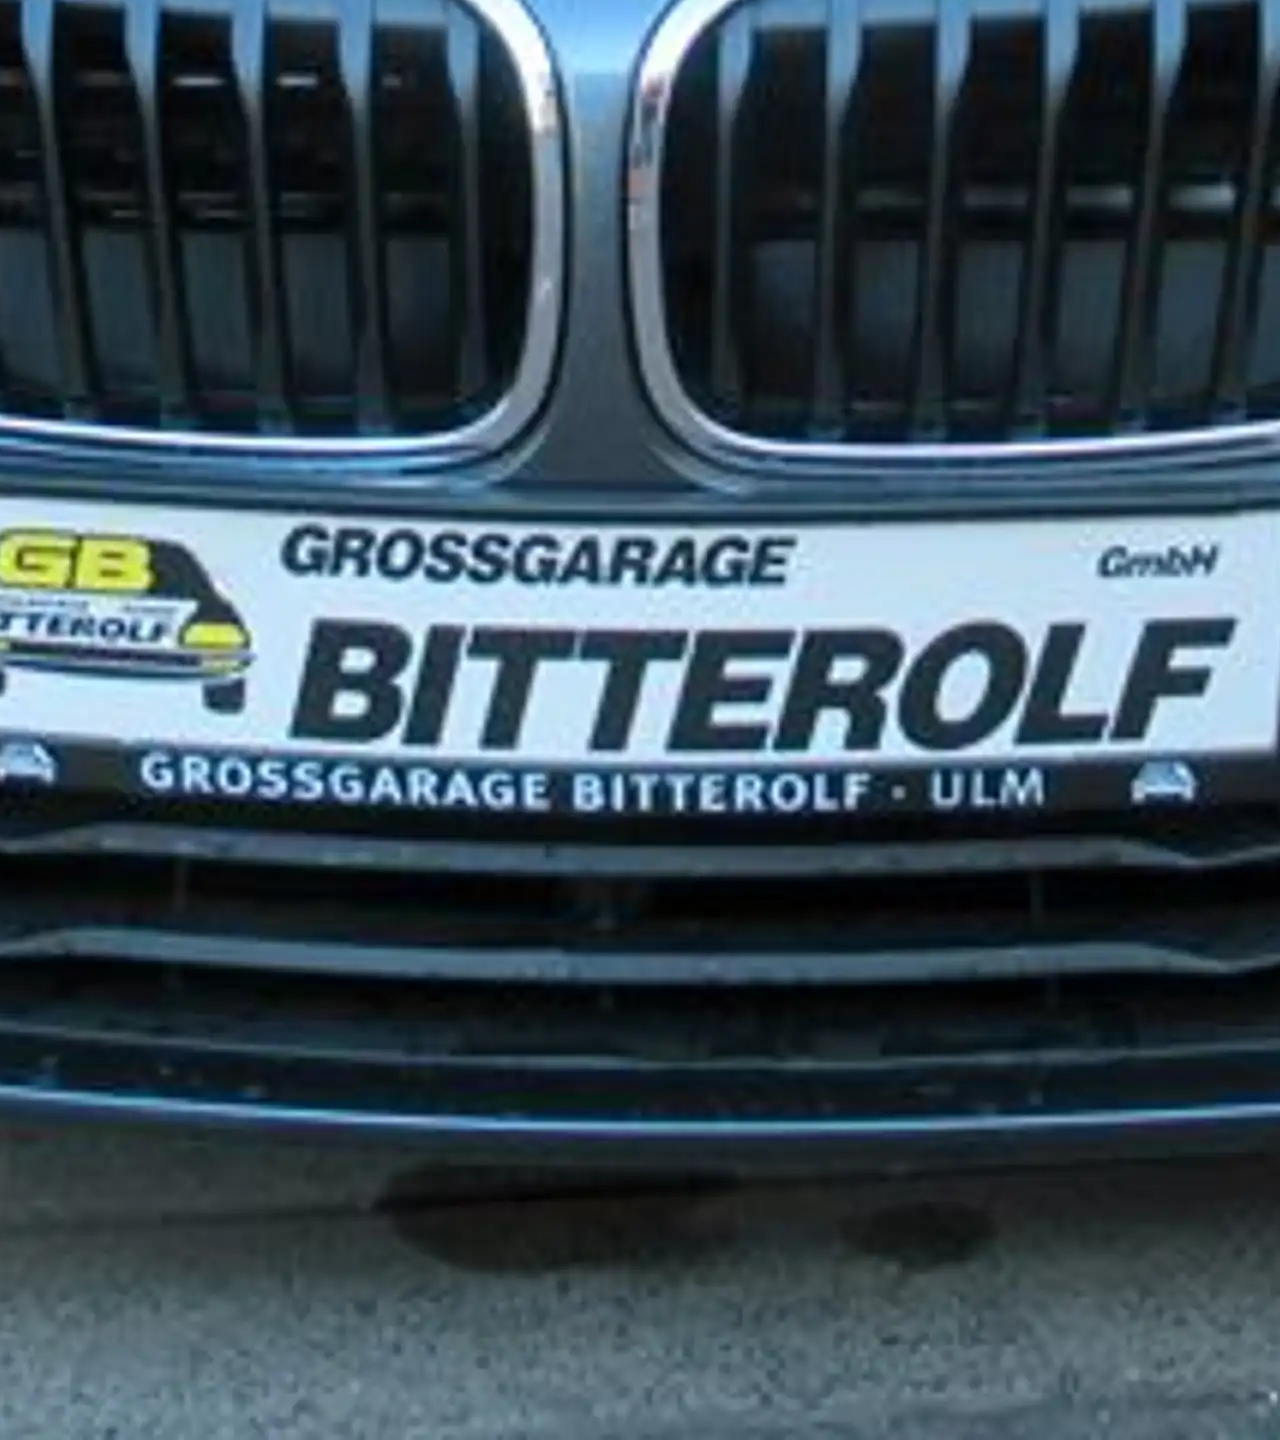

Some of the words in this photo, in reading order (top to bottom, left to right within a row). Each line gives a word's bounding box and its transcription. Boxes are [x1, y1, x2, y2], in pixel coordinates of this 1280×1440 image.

[280, 525, 796, 587] GROSSGARAGE
[1097, 543, 1219, 579] GmbH
[289, 618, 1237, 752] BITTEROLF
[140, 753, 550, 811] GROSSGARAGE
[572, 771, 871, 813] BITTEROLF
[929, 768, 1045, 808] ULM
